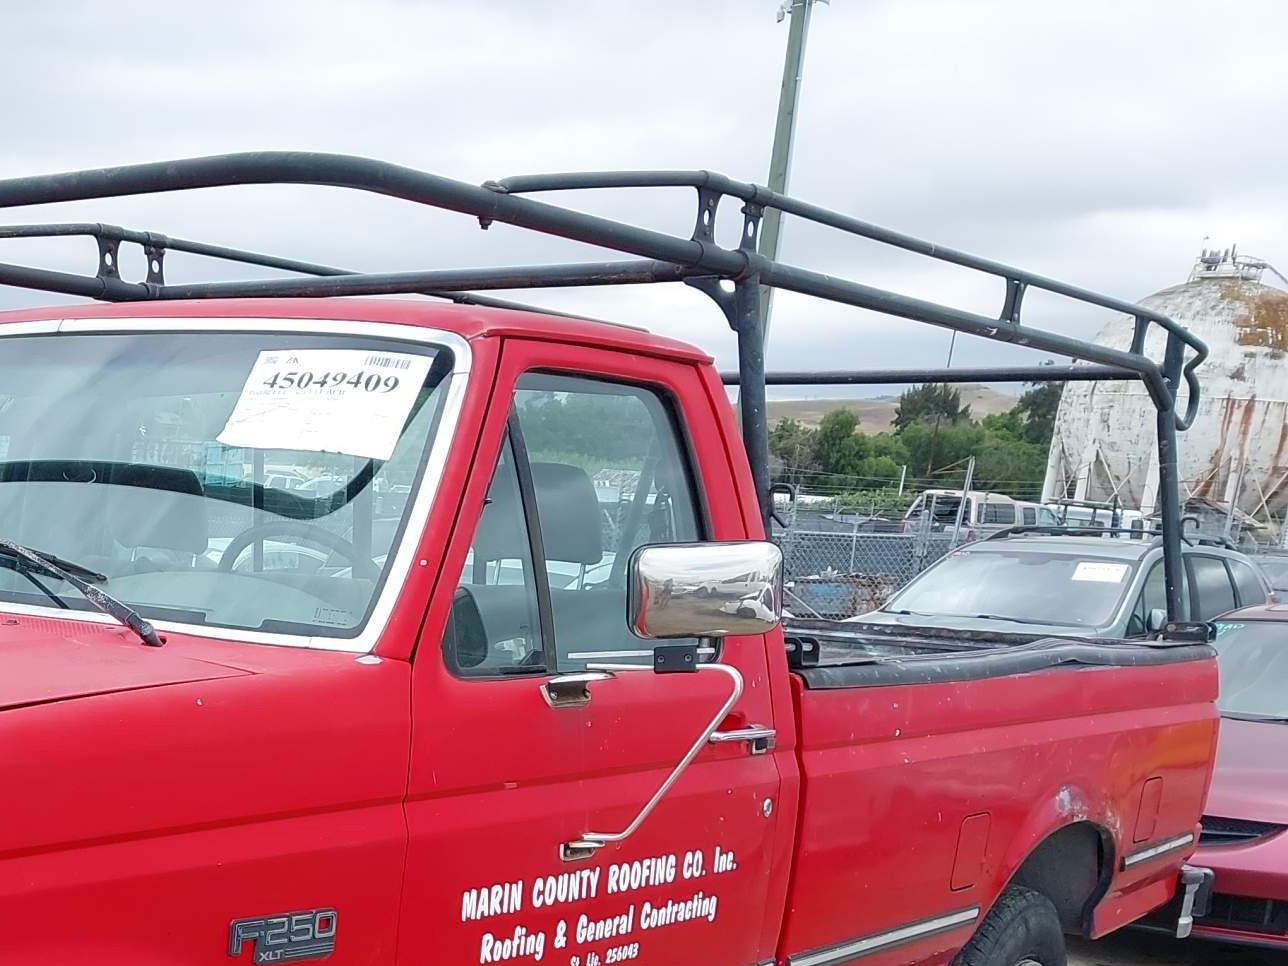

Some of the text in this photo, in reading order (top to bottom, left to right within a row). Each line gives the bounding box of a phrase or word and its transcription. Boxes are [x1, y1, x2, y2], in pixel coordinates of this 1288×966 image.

[263, 370, 400, 394] 45049409
[461, 845, 737, 922] MARIN COUNTY ROOFING CO. Inc.
[479, 891, 718, 964] Roofing & General Contracting
[259, 949, 284, 962] XLT
[605, 942, 640, 964] 256043
